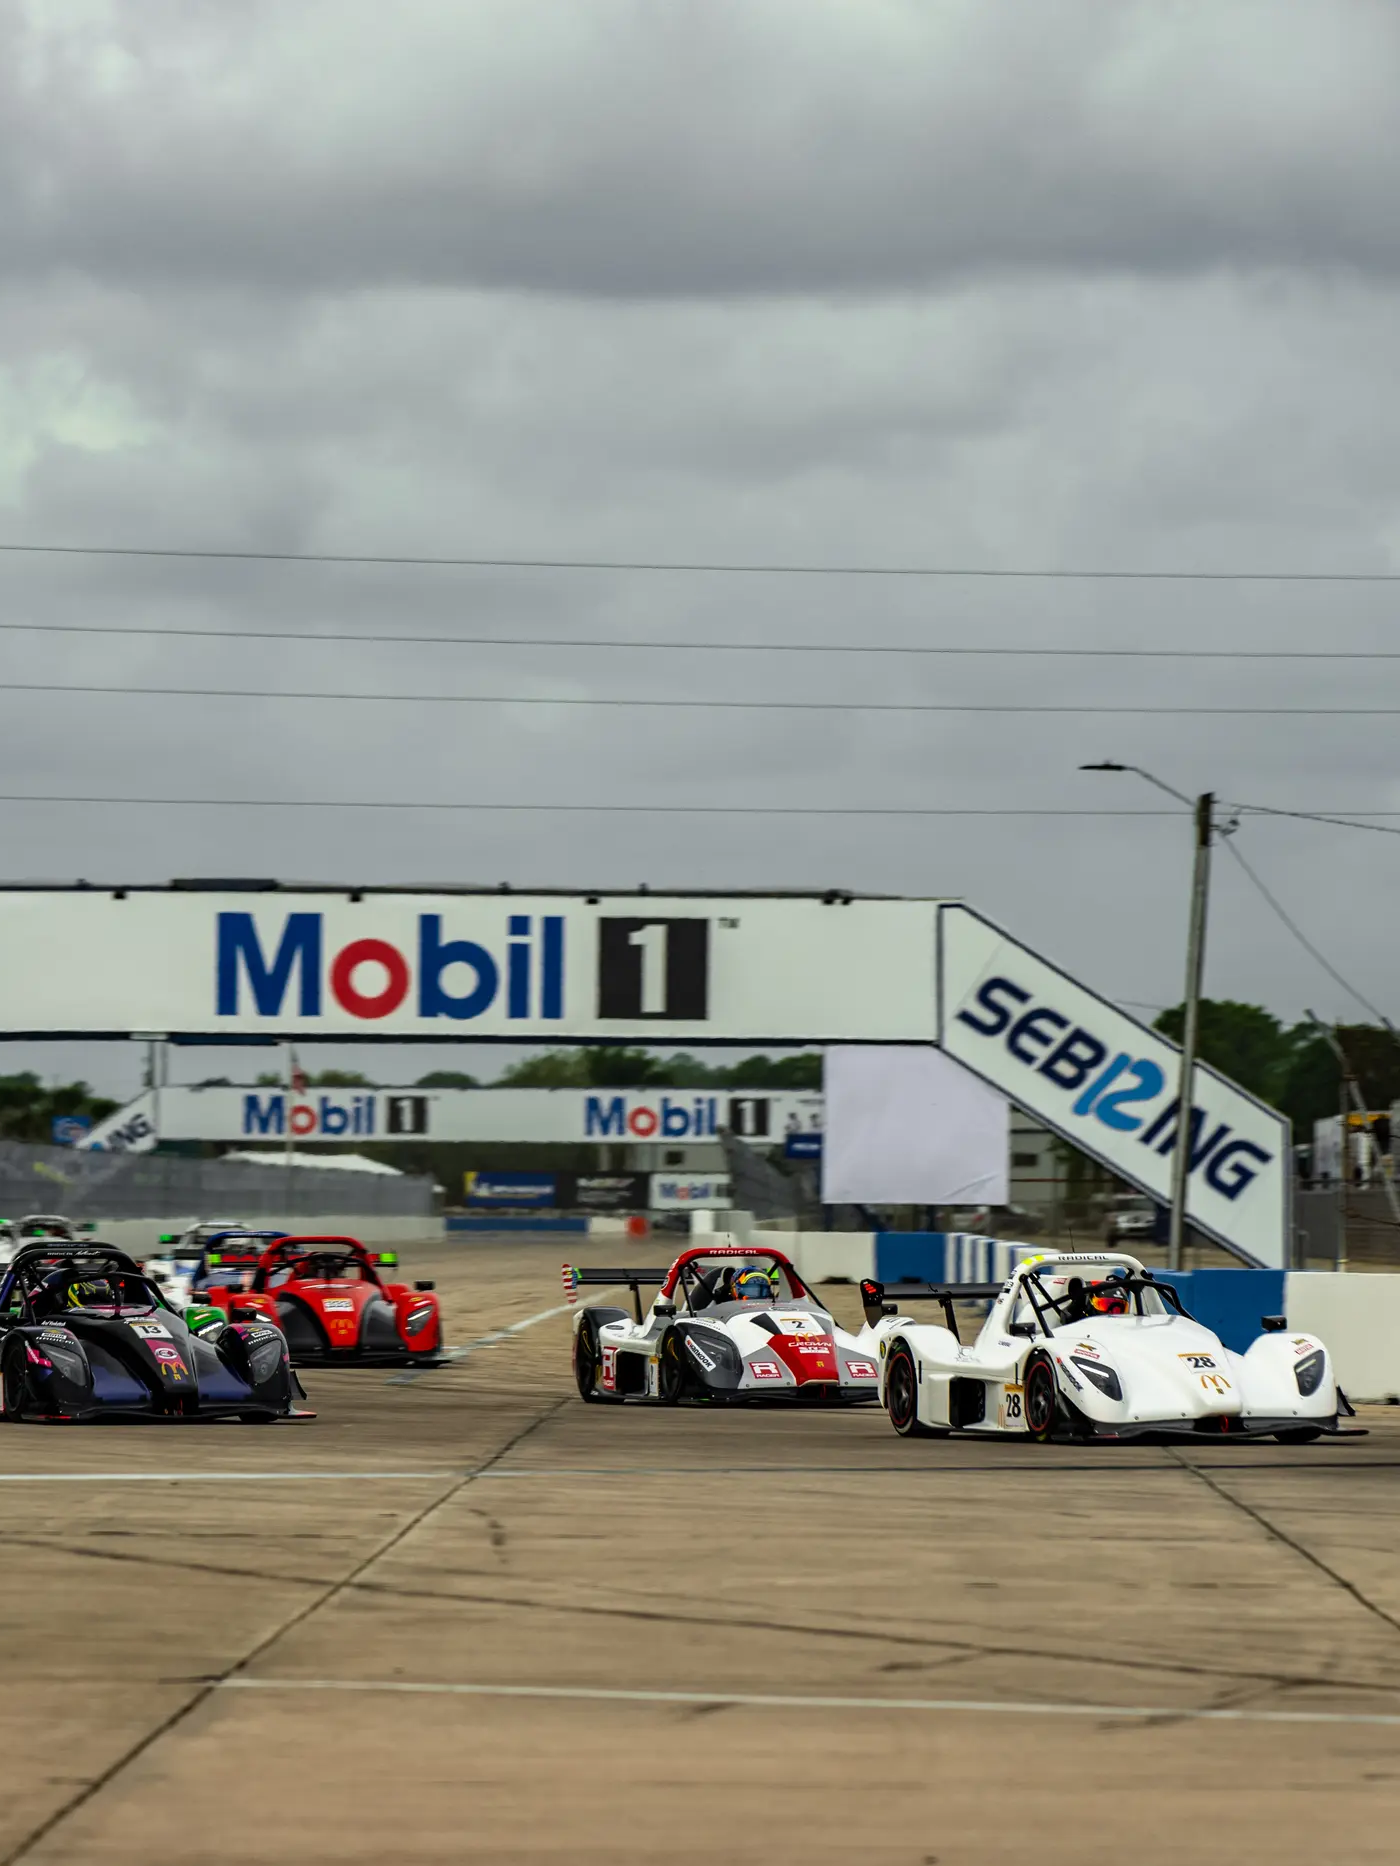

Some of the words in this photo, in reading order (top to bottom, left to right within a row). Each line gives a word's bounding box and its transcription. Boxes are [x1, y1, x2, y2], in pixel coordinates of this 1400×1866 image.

[216, 912, 564, 1020] Mobil
[628, 924, 668, 1013] 1
[243, 1095, 376, 1136] Mobil
[584, 1096, 718, 1137] Mobil
[139, 1325, 162, 1334] 13
[1187, 1356, 1216, 1368] 28
[1006, 1394, 1021, 1418] 28
